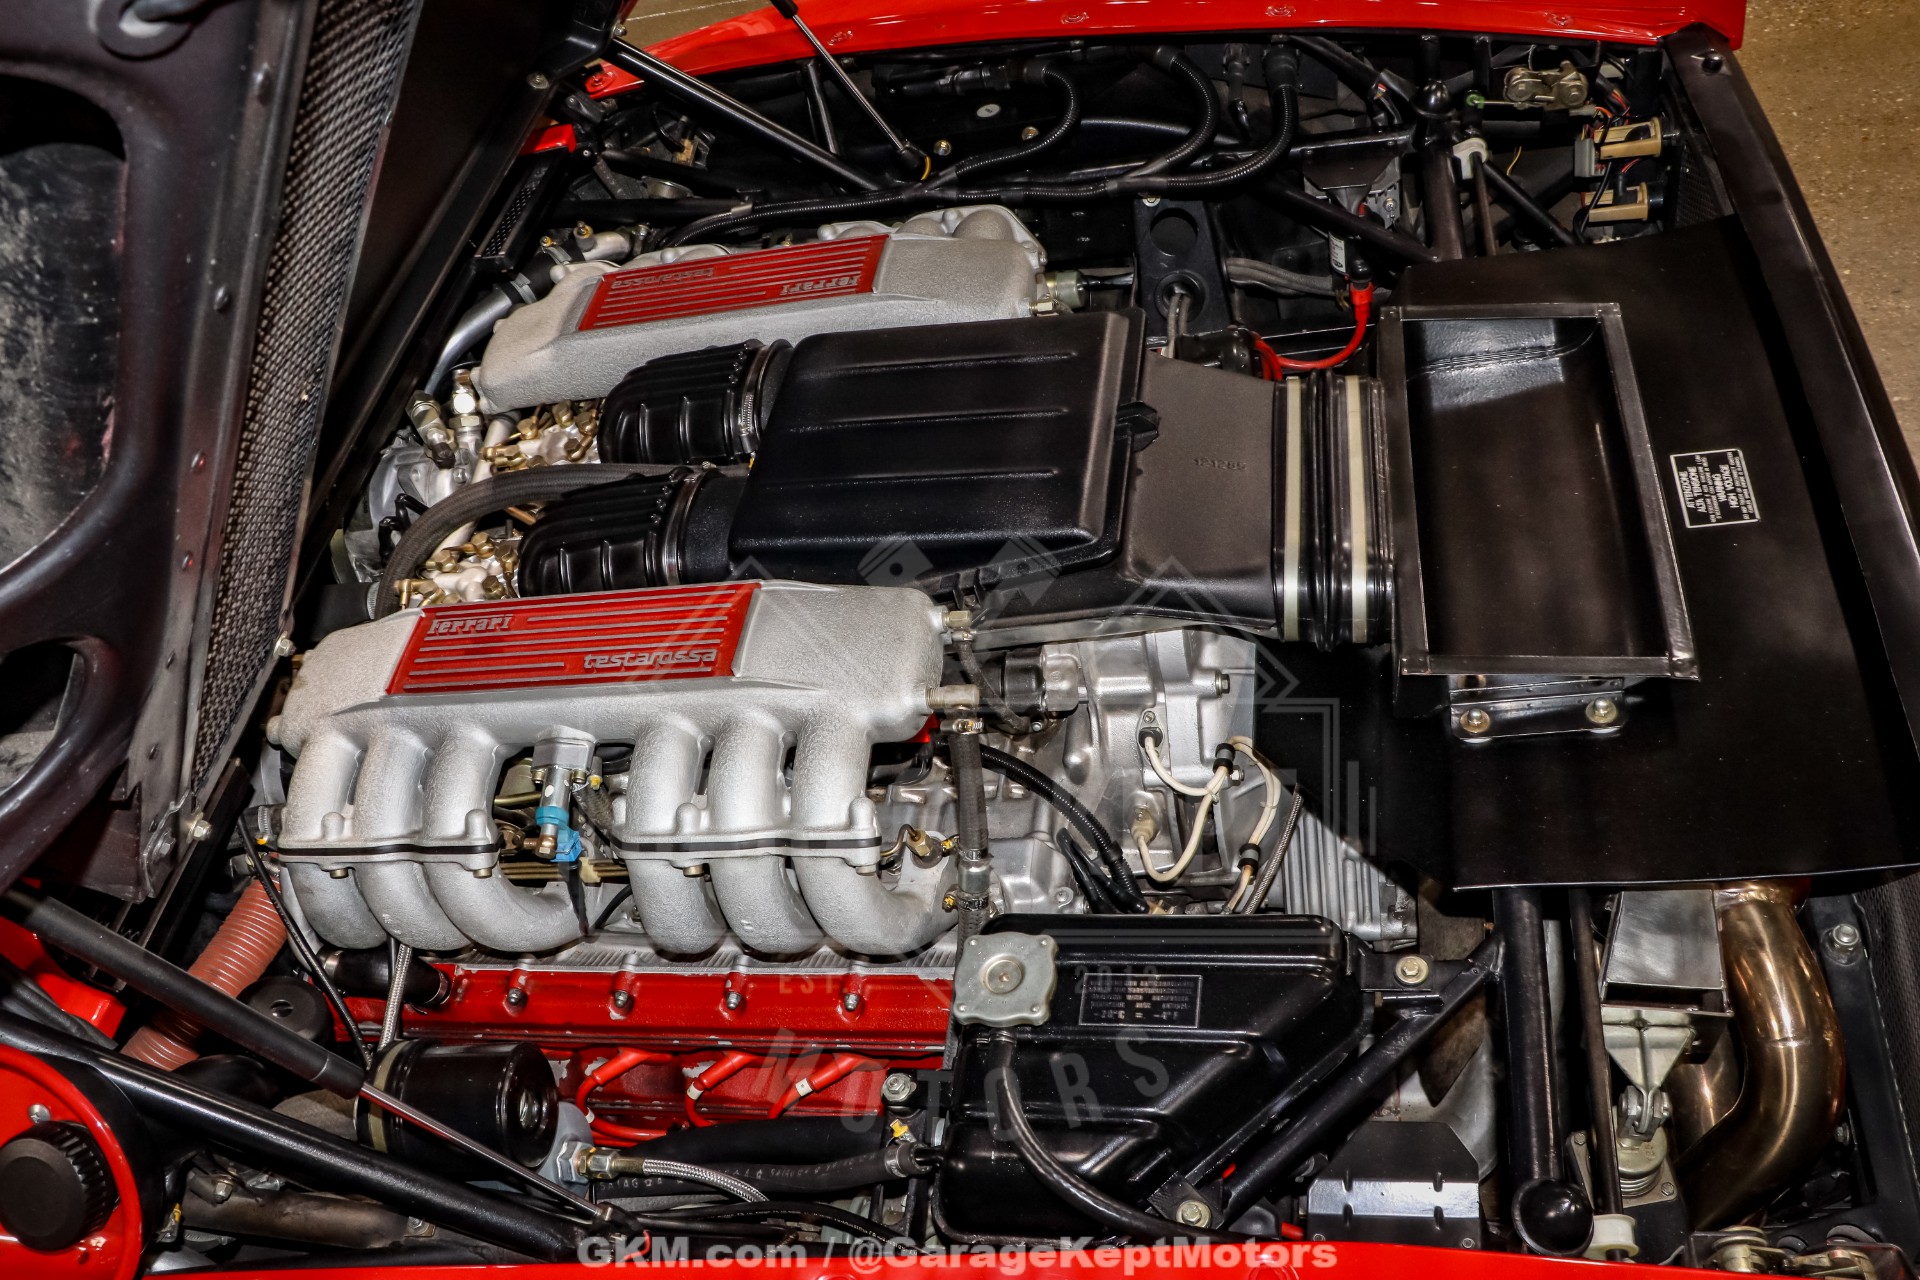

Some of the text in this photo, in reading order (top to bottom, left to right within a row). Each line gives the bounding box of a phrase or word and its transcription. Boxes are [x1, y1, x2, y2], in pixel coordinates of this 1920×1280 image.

[780, 275, 862, 297] Ferrari
[427, 612, 514, 635] Ferrari
[583, 648, 718, 669] testarossa
